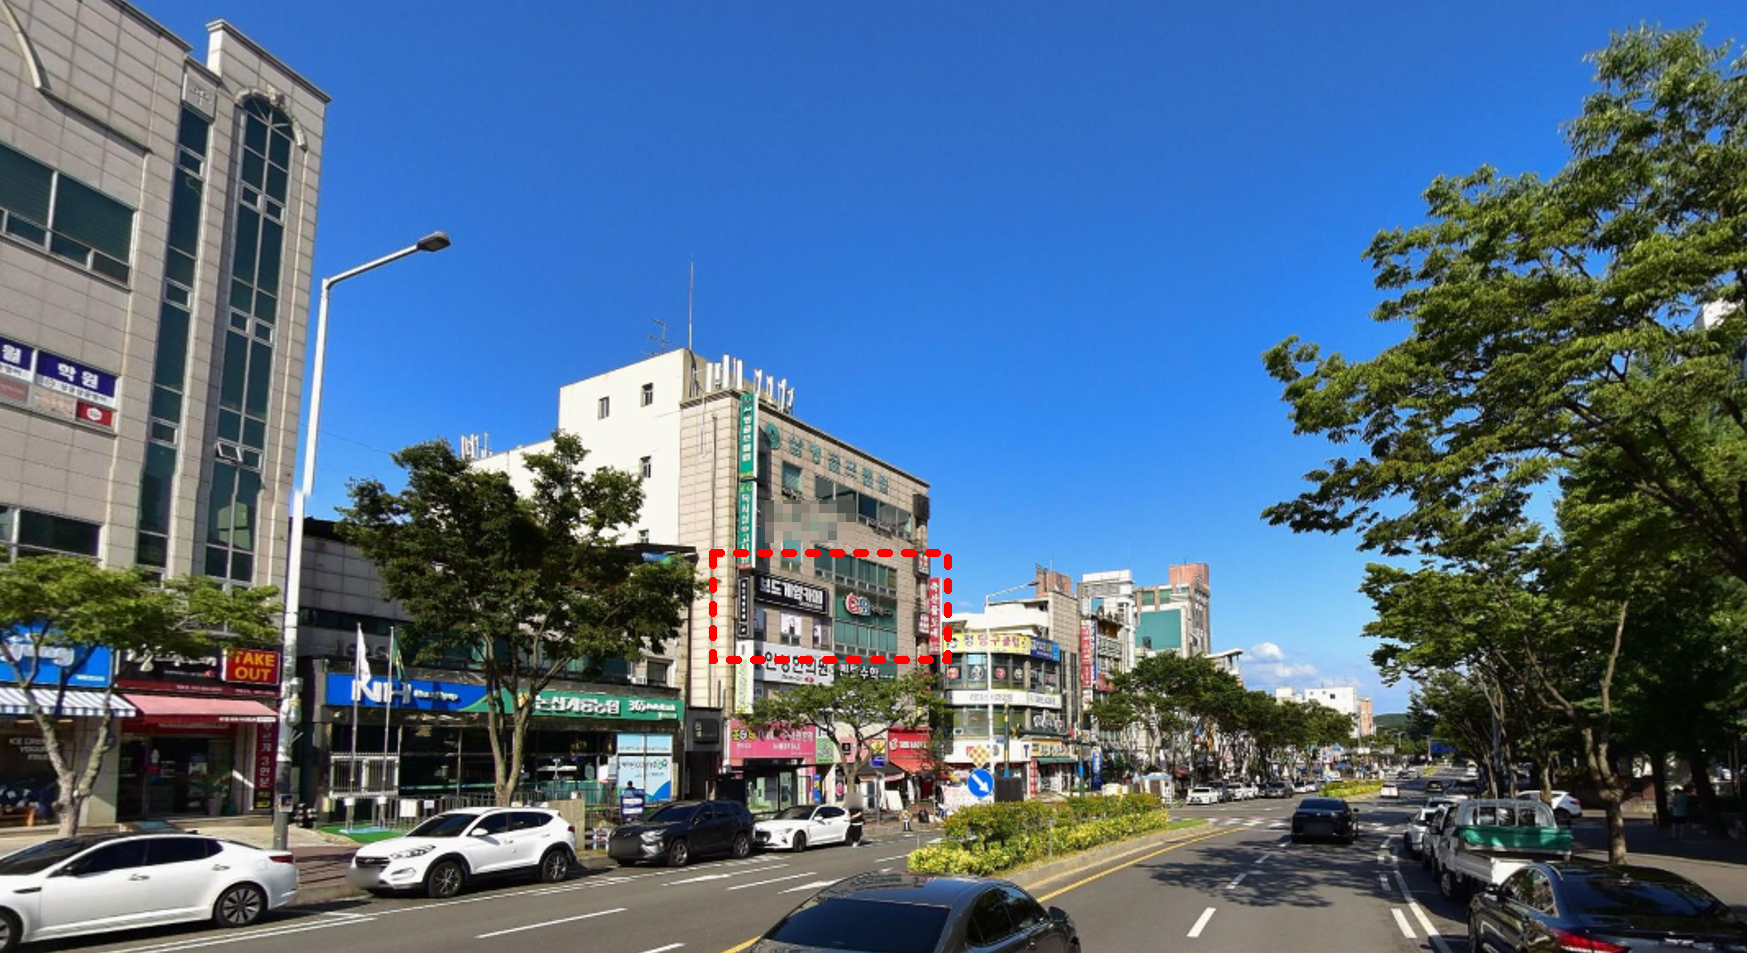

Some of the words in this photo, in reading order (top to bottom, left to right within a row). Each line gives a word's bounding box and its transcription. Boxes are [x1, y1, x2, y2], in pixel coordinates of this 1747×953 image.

[760, 577, 824, 605] 보드게임카페
[232, 651, 275, 667] TAKE
[235, 666, 271, 681] OUT
[352, 679, 411, 704] NH
